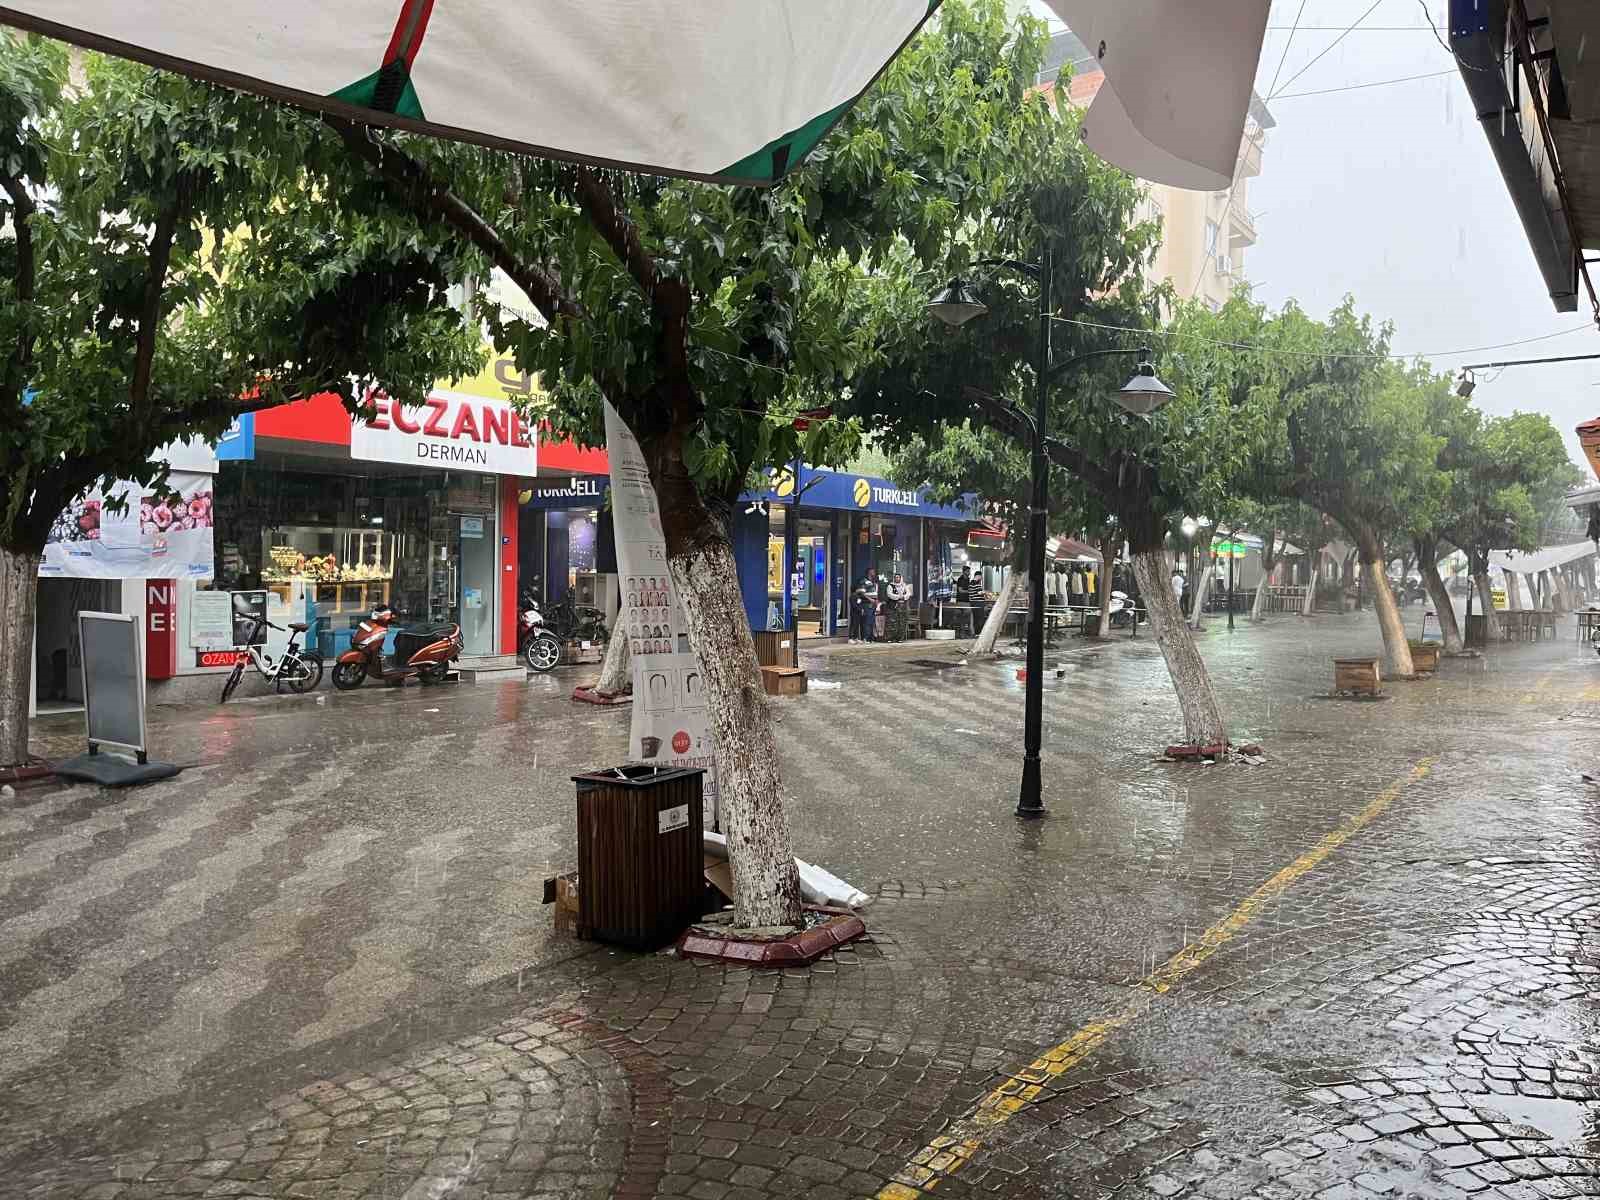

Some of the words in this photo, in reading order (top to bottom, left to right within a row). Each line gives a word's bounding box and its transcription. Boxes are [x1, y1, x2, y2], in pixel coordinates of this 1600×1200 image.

[364, 386, 532, 449] ECZANE
[417, 442, 488, 465] DERMAN
[872, 487, 920, 507] TURKCELL
